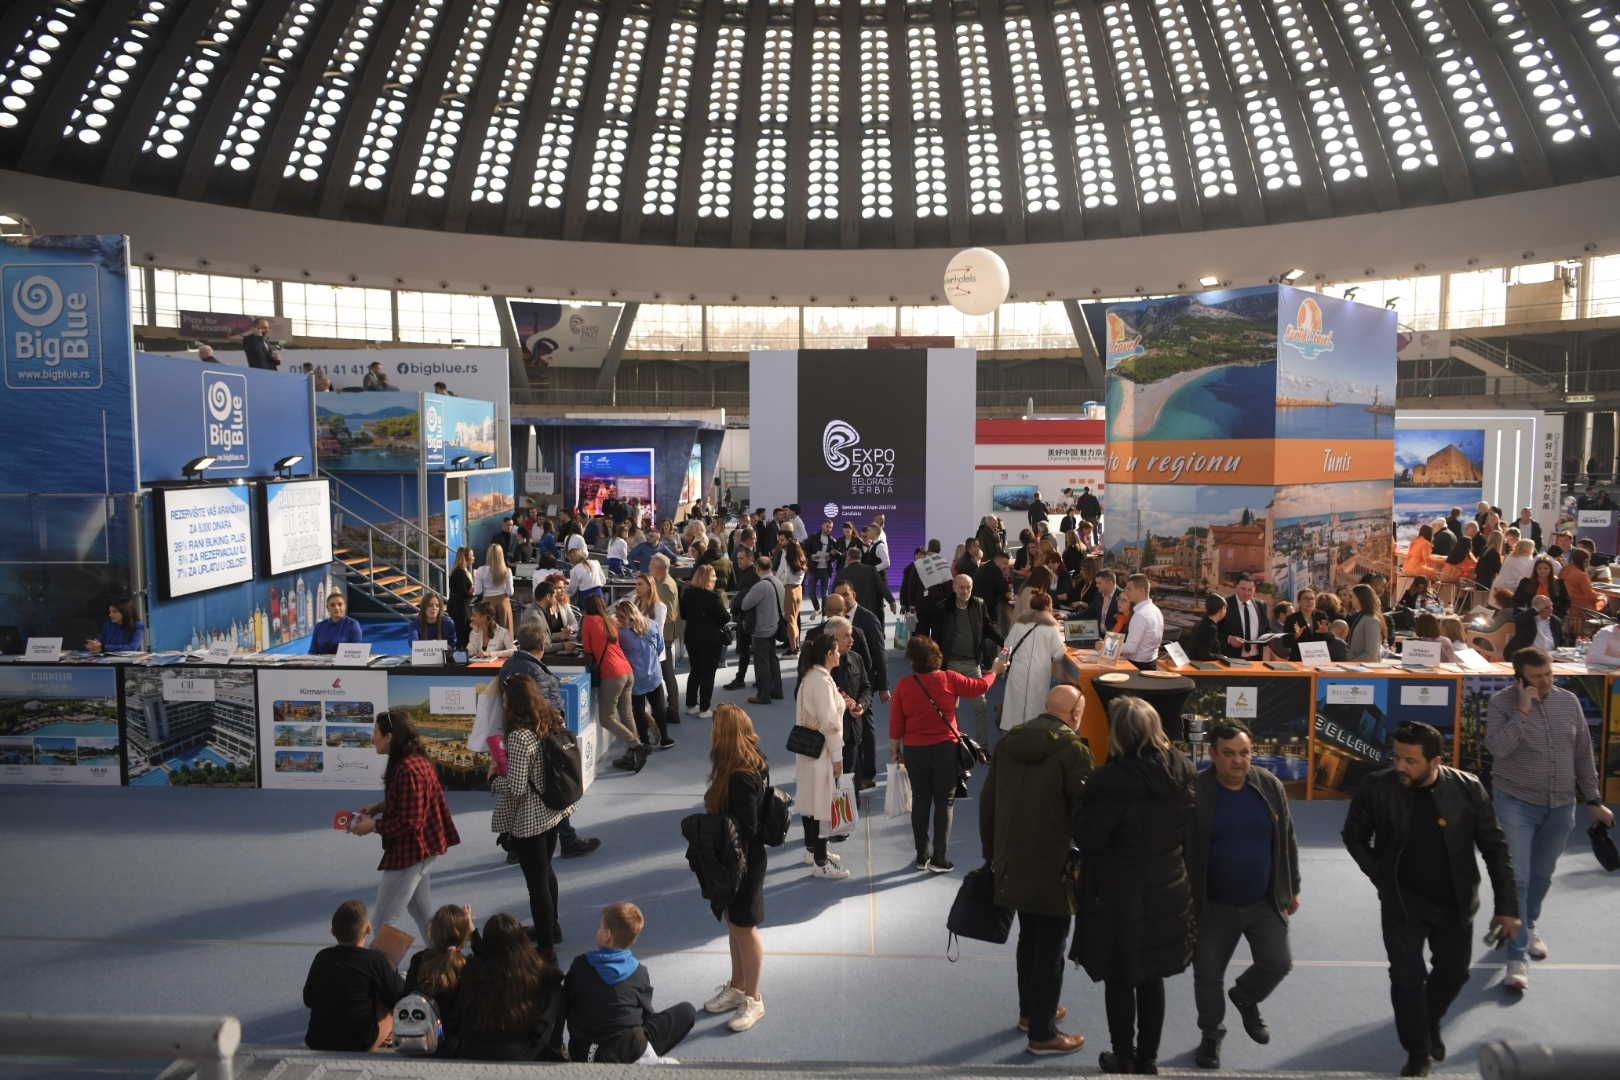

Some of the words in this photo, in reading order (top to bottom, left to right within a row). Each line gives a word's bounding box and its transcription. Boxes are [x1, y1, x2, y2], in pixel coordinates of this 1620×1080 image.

[61, 292, 89, 359] Blue
[183, 315, 202, 325] Play
[205, 317, 217, 325] for
[191, 324, 232, 333] Humanity
[15, 330, 60, 367] Big
[17, 369, 90, 381] www.bigblue.rs
[333, 365, 346, 375] 41
[410, 362, 478, 376] bigblue.rs
[231, 396, 244, 446] Blue
[210, 423, 231, 451] Big
[428, 433, 437, 453] Big
[852, 448, 895, 463] EXPO
[1322, 449, 1352, 474] Tunis
[852, 463, 895, 477] 2027
[1125, 456, 1139, 472] u
[1146, 450, 1241, 482] regionu
[851, 477, 894, 486] BELGRADE
[851, 486, 894, 495] SERBIA
[278, 489, 296, 509] RANI
[170, 505, 206, 521] REZERVIŠITE
[206, 504, 217, 516] VAŠ
[217, 502, 246, 515] ARANŽMAN
[189, 524, 197, 534] ZA
[212, 520, 232, 531] DINARA
[188, 538, 204, 550] RANI
[230, 532, 246, 544] PLUS
[189, 552, 198, 563] ZA
[188, 565, 197, 577] ZA
[198, 562, 220, 575] UPLATU
[31, 672, 72, 681] CORNELIA
[1314, 713, 1382, 762] BELLEVUE
